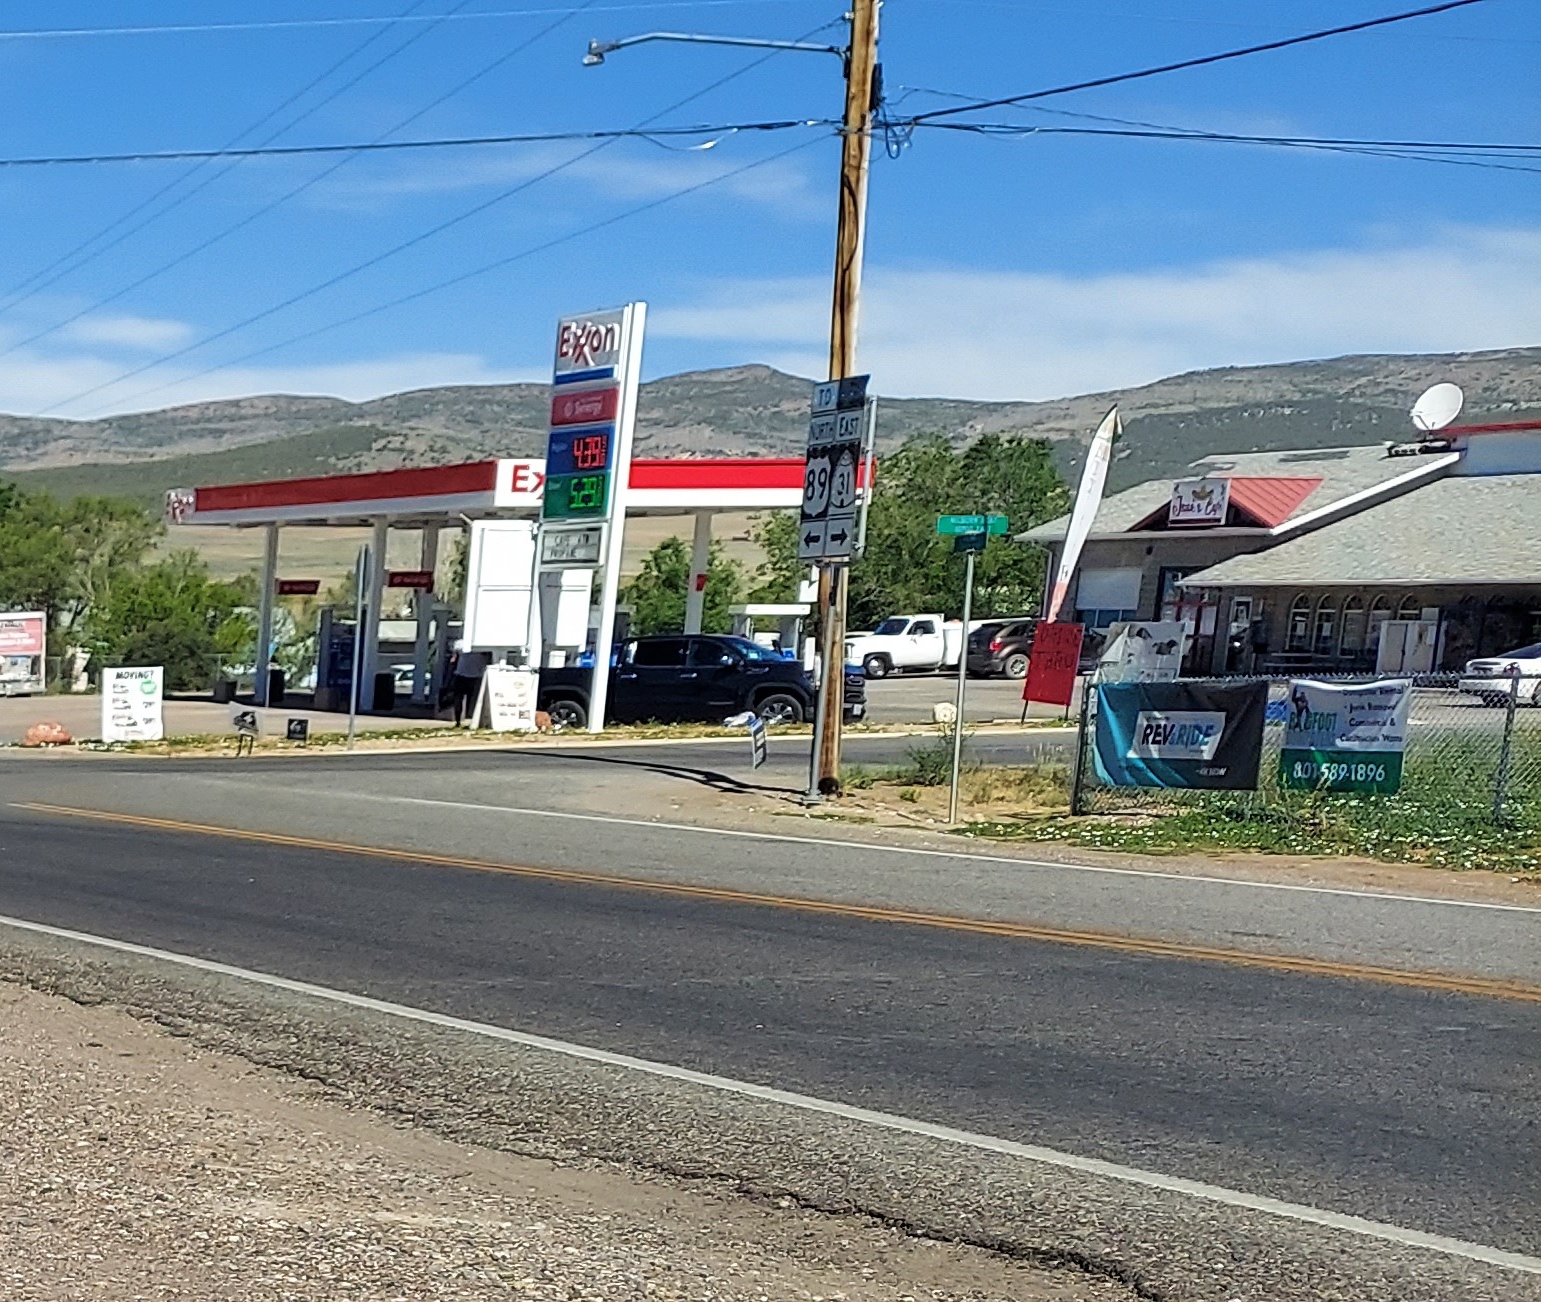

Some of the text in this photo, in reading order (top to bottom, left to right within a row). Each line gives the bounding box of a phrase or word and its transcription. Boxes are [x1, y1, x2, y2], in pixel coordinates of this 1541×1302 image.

[559, 322, 620, 366] Exxon
[819, 387, 831, 405] TO
[838, 416, 859, 437] EAST
[511, 464, 545, 500] Ex
[806, 467, 851, 501] 89 31
